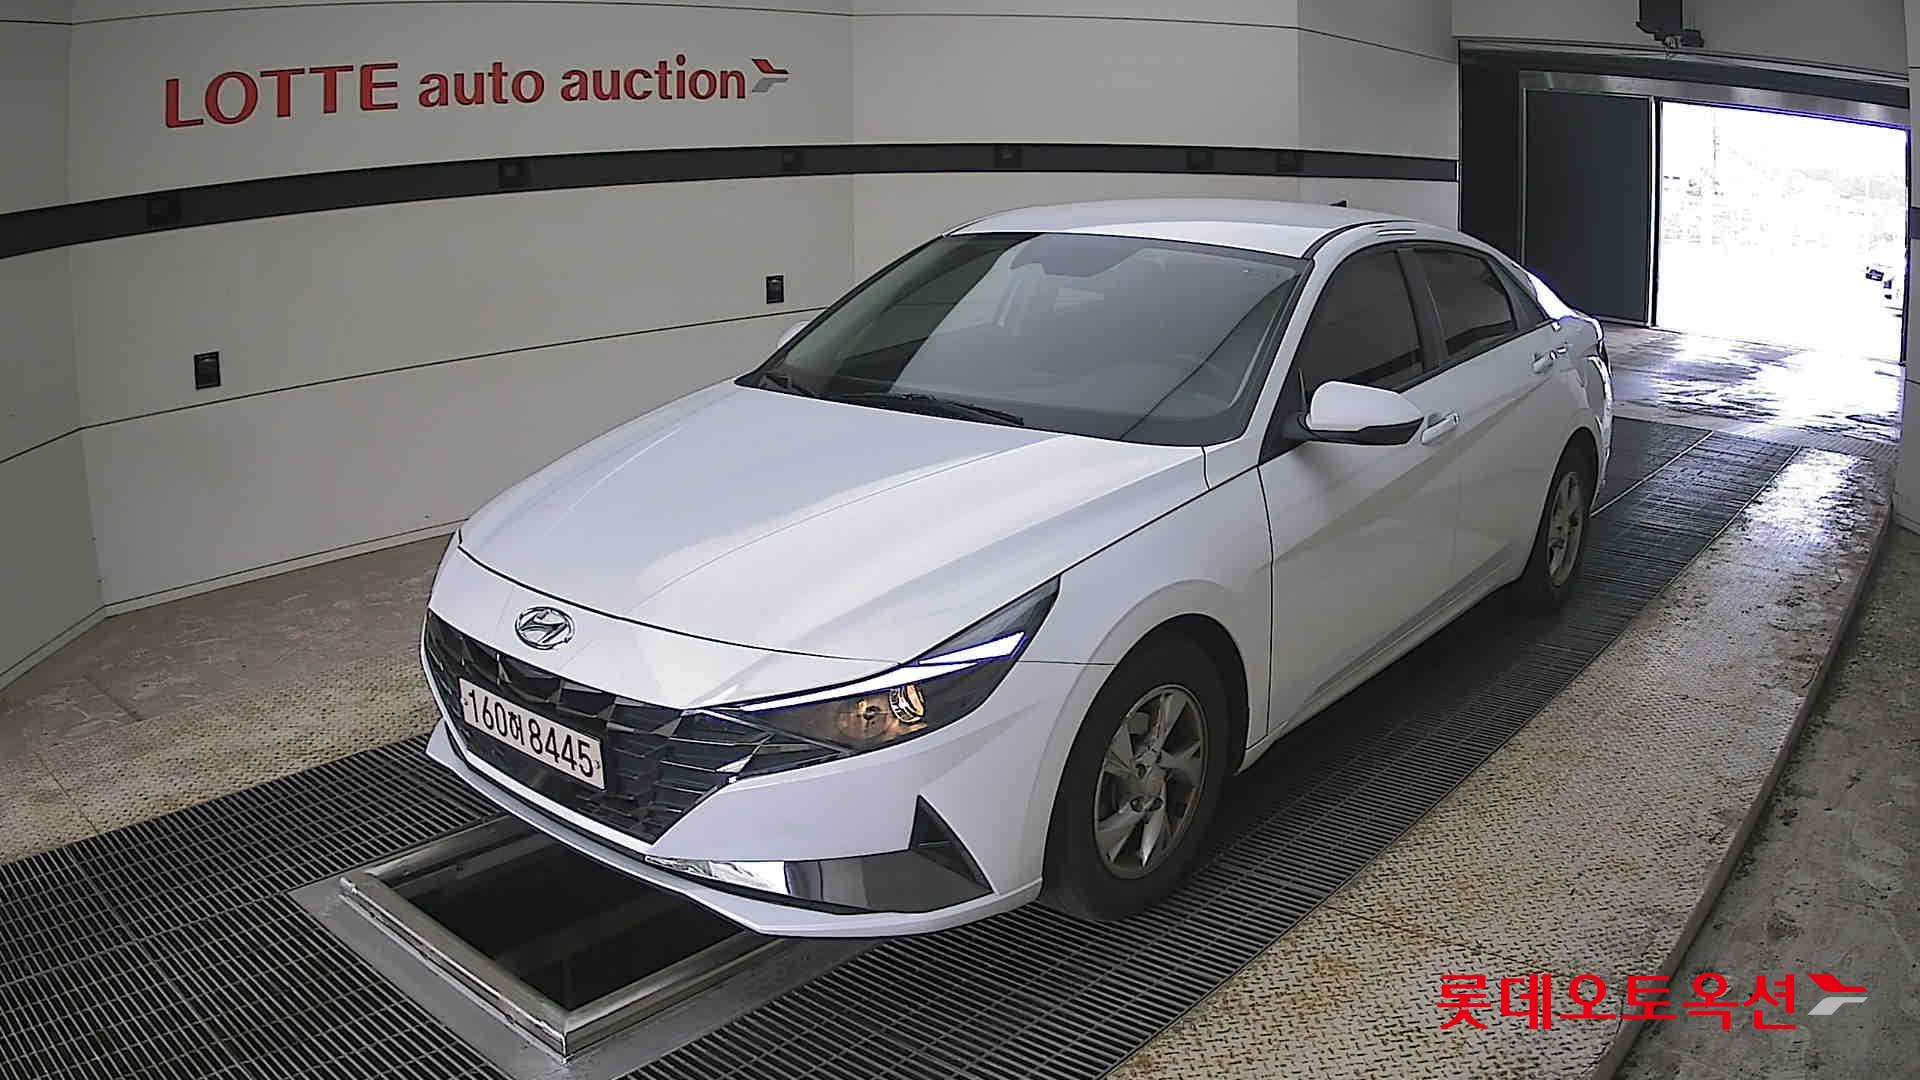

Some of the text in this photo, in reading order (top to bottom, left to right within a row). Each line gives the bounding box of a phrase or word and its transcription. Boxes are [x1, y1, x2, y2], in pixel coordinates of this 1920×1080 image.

[165, 54, 746, 128] LOTTE auto auction
[528, 719, 594, 778] 8445
